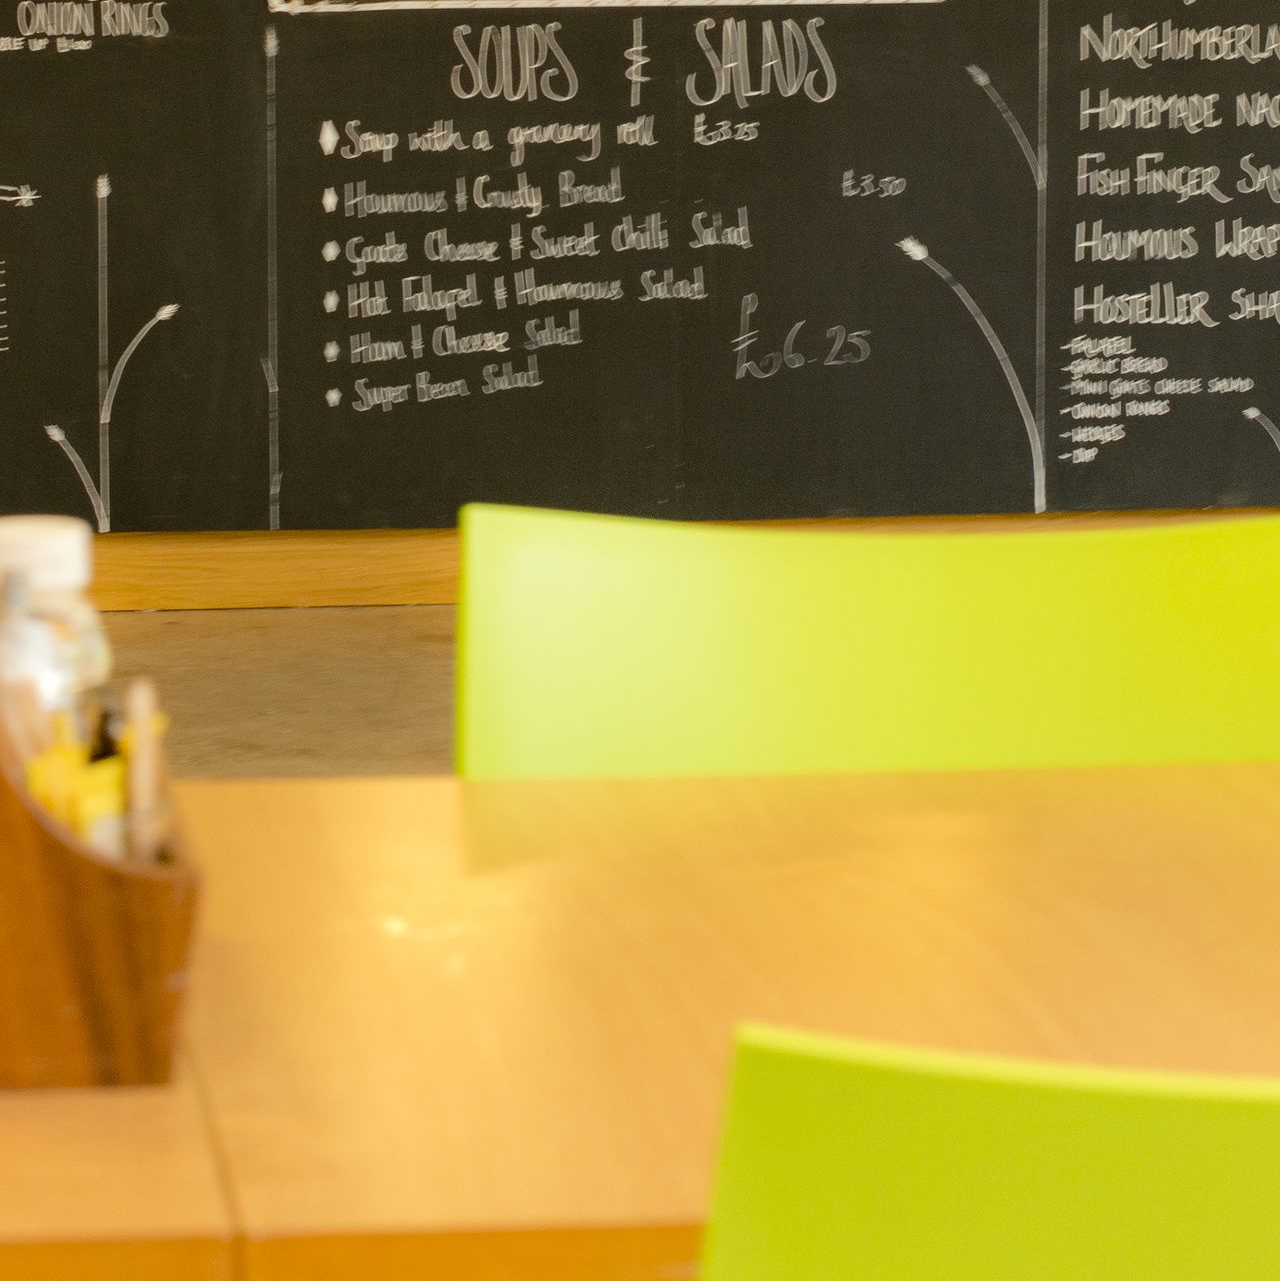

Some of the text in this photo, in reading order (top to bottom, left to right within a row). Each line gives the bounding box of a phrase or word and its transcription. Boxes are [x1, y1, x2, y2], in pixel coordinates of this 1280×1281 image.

[16, 0, 169, 38] ONION RINGS
[451, 21, 579, 102] SOUPS
[686, 17, 837, 109] SALADS
[1079, 87, 1222, 134] HOMEMADE
[340, 120, 399, 163] Soup
[408, 119, 469, 152] with
[472, 129, 494, 152] a
[507, 122, 601, 167] granary
[617, 114, 659, 146] roll
[473, 172, 547, 218] Crusty
[558, 166, 625, 208] Bread
[1077, 152, 1129, 197] FISH
[1136, 151, 1233, 203] FINGER
[345, 230, 408, 276] Goats
[424, 227, 501, 262] Cheese
[530, 222, 600, 260] Sweet
[689, 205, 753, 249] Salad
[1075, 219, 1199, 262] HOUMOUS
[348, 279, 392, 317] Hot
[402, 273, 483, 321] Falafel
[514, 267, 624, 306] Houmous
[639, 265, 708, 302] Salad
[350, 331, 407, 364] Ham
[432, 324, 511, 357] Cheese
[525, 308, 583, 350] Salad
[352, 354, 544, 412] Super Bean Salad
